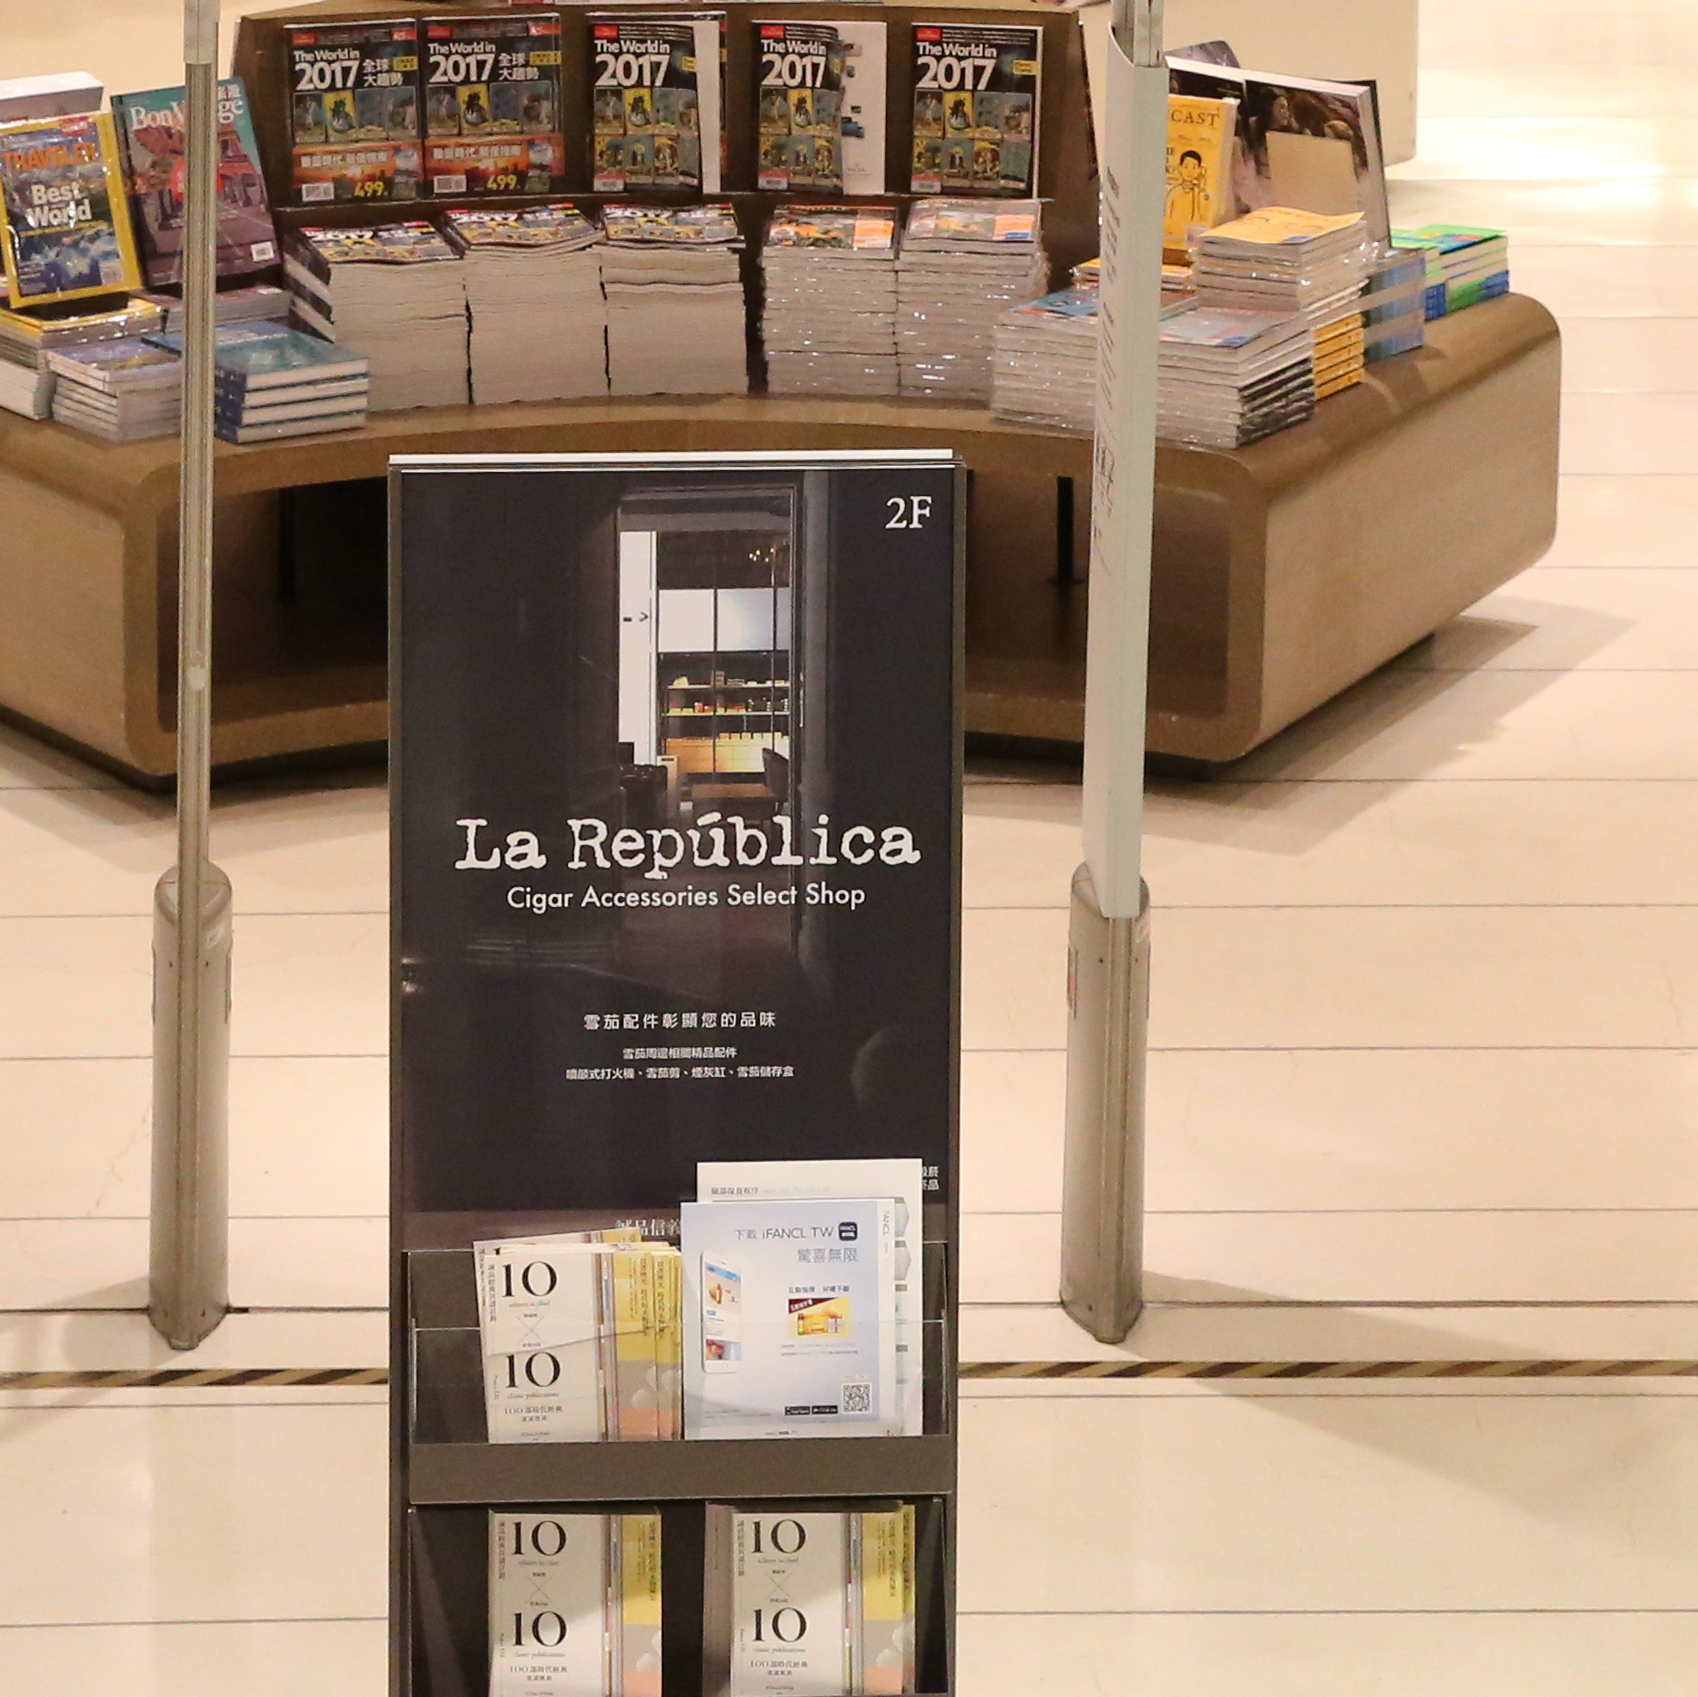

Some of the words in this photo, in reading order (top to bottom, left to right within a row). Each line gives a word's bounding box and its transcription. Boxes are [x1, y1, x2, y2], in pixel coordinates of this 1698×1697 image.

[294, 50, 314, 62] The
[314, 49, 349, 61] World
[350, 48, 360, 60] in
[428, 42, 448, 54] The
[449, 41, 484, 54] World
[485, 42, 496, 52] in
[498, 52, 526, 66] 全球
[594, 39, 619, 53] The
[620, 39, 658, 53] World
[659, 40, 671, 54] in
[761, 39, 785, 53] The
[786, 40, 816, 55] World
[817, 42, 827, 55] in
[916, 41, 942, 55] The
[943, 41, 977, 57] World
[980, 43, 997, 57] in
[295, 60, 360, 91] 2017
[362, 58, 391, 72] 全球
[429, 54, 496, 84] 2017
[595, 53, 671, 87] 2017
[761, 54, 827, 89] 2017
[916, 57, 996, 91] 2017
[130, 106, 170, 131] Bon
[4, 141, 99, 172] TRAVELER
[31, 182, 82, 205] Best
[353, 179, 386, 197] 499
[486, 174, 518, 191] 499
[25, 199, 93, 229] World
[885, 495, 932, 529] 2F
[455, 817, 547, 870] La
[567, 811, 922, 879] República
[507, 886, 573, 913] Cigar
[581, 885, 719, 907] Accessories
[727, 883, 798, 906] Select
[805, 882, 866, 909] Shop
[583, 1011, 777, 1030] 雪茄配件彰顯您的品味
[762, 1226, 807, 1240] iFANCL
[811, 1226, 834, 1239] TW
[796, 1248, 859, 1264] 驚喜無限
[501, 1260, 558, 1299] 10
[505, 1351, 561, 1388] 10
[512, 1520, 567, 1557] 10
[752, 1518, 807, 1554] 10
[512, 1611, 567, 1647] 10
[753, 1606, 808, 1643] 10
